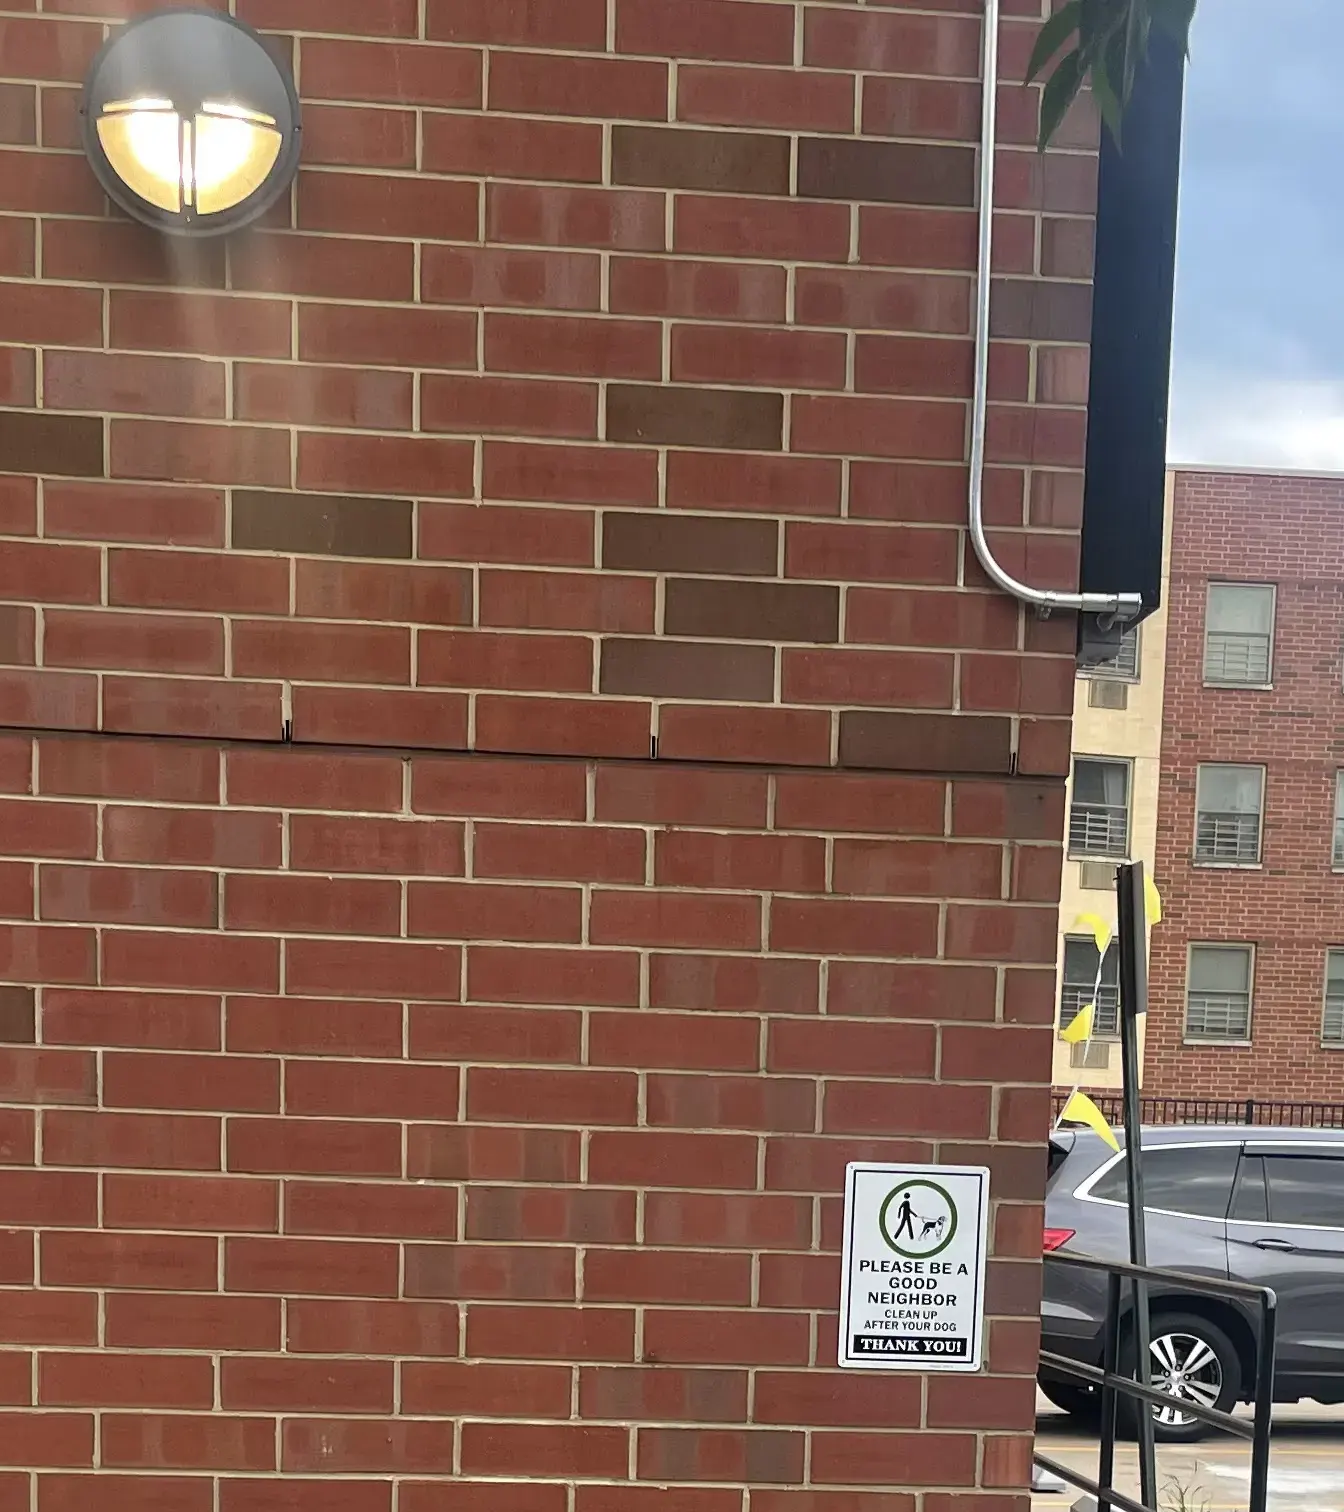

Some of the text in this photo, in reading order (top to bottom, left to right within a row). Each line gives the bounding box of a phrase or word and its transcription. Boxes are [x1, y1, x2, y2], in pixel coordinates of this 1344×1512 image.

[859, 1259, 968, 1275] PLEASE BE A
[888, 1277, 938, 1290] GOOD
[867, 1291, 957, 1307] NEIGHBOR
[884, 1309, 938, 1320] CLEAN UP
[863, 1320, 957, 1332] AFTER YOUR DOG
[860, 1338, 962, 1353] THANK YOU!
